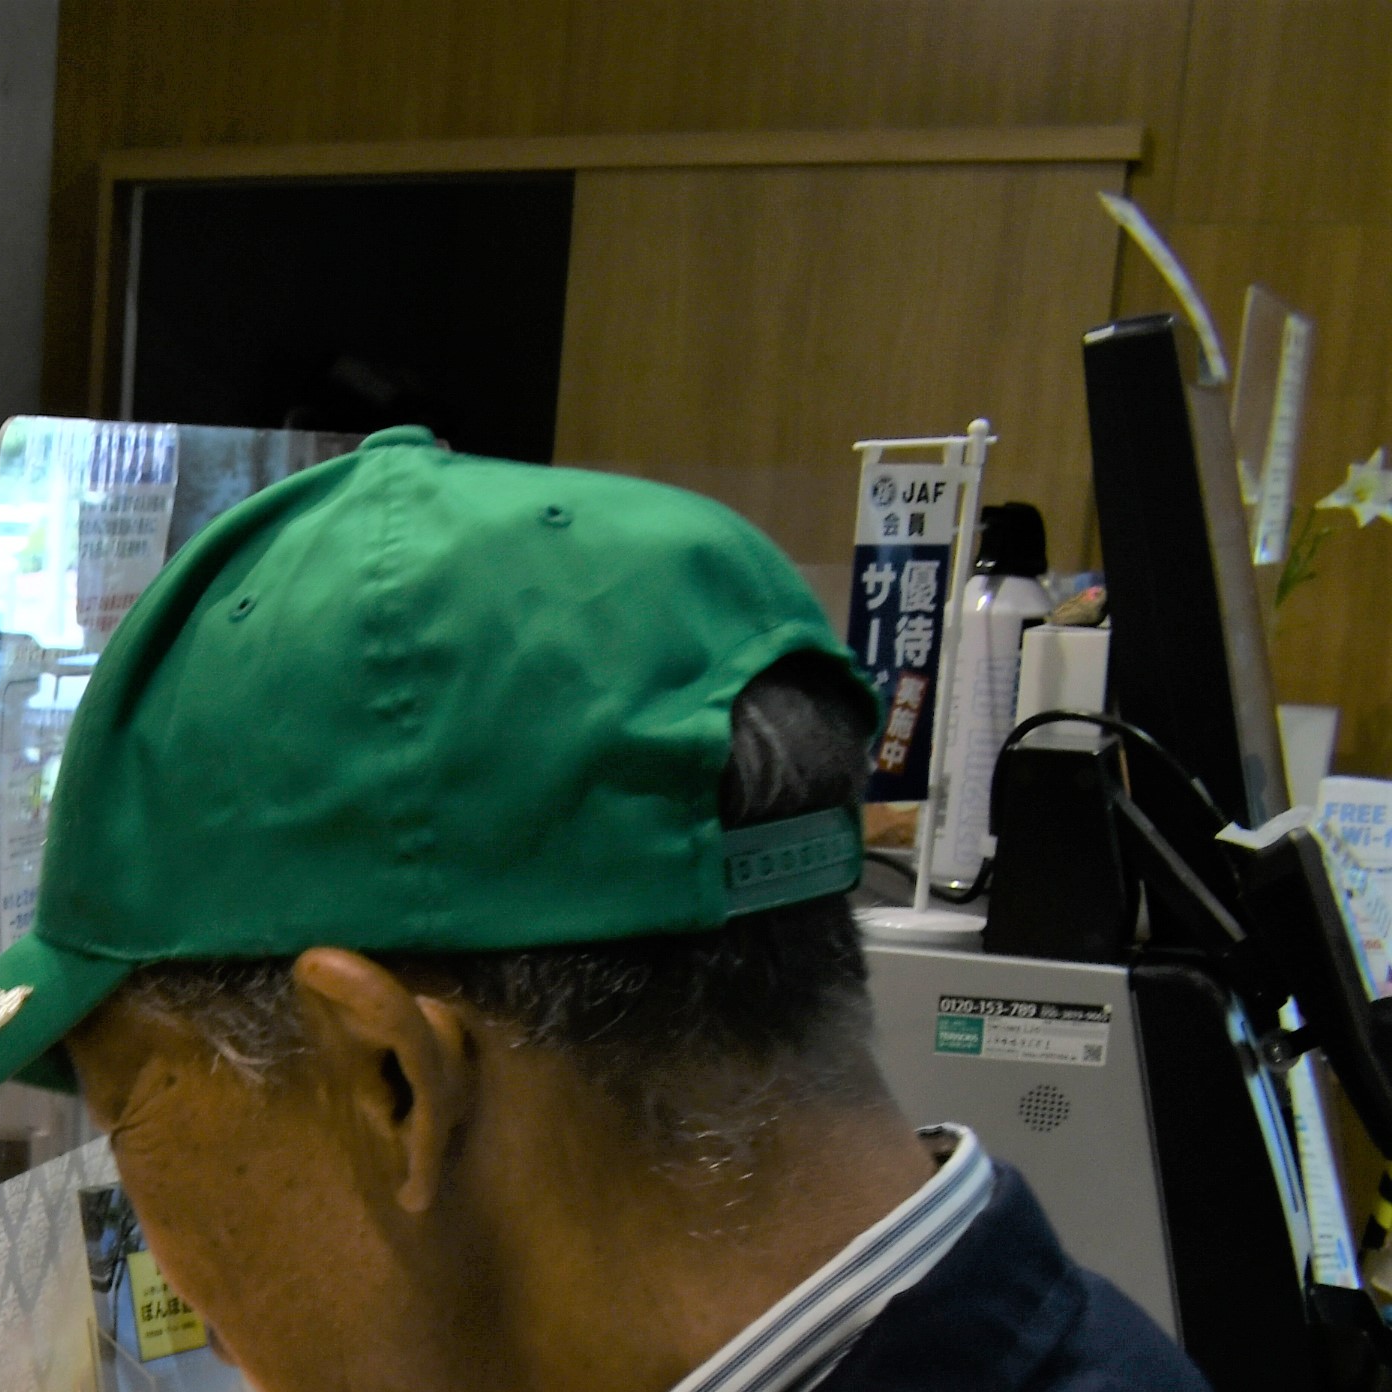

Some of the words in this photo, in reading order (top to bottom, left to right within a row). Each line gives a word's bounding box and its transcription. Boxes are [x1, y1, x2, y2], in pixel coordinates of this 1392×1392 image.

[902, 481, 946, 504] JAF
[883, 512, 925, 537] 会員
[895, 559, 940, 667] 優待
[1324, 802, 1387, 825] FREE
